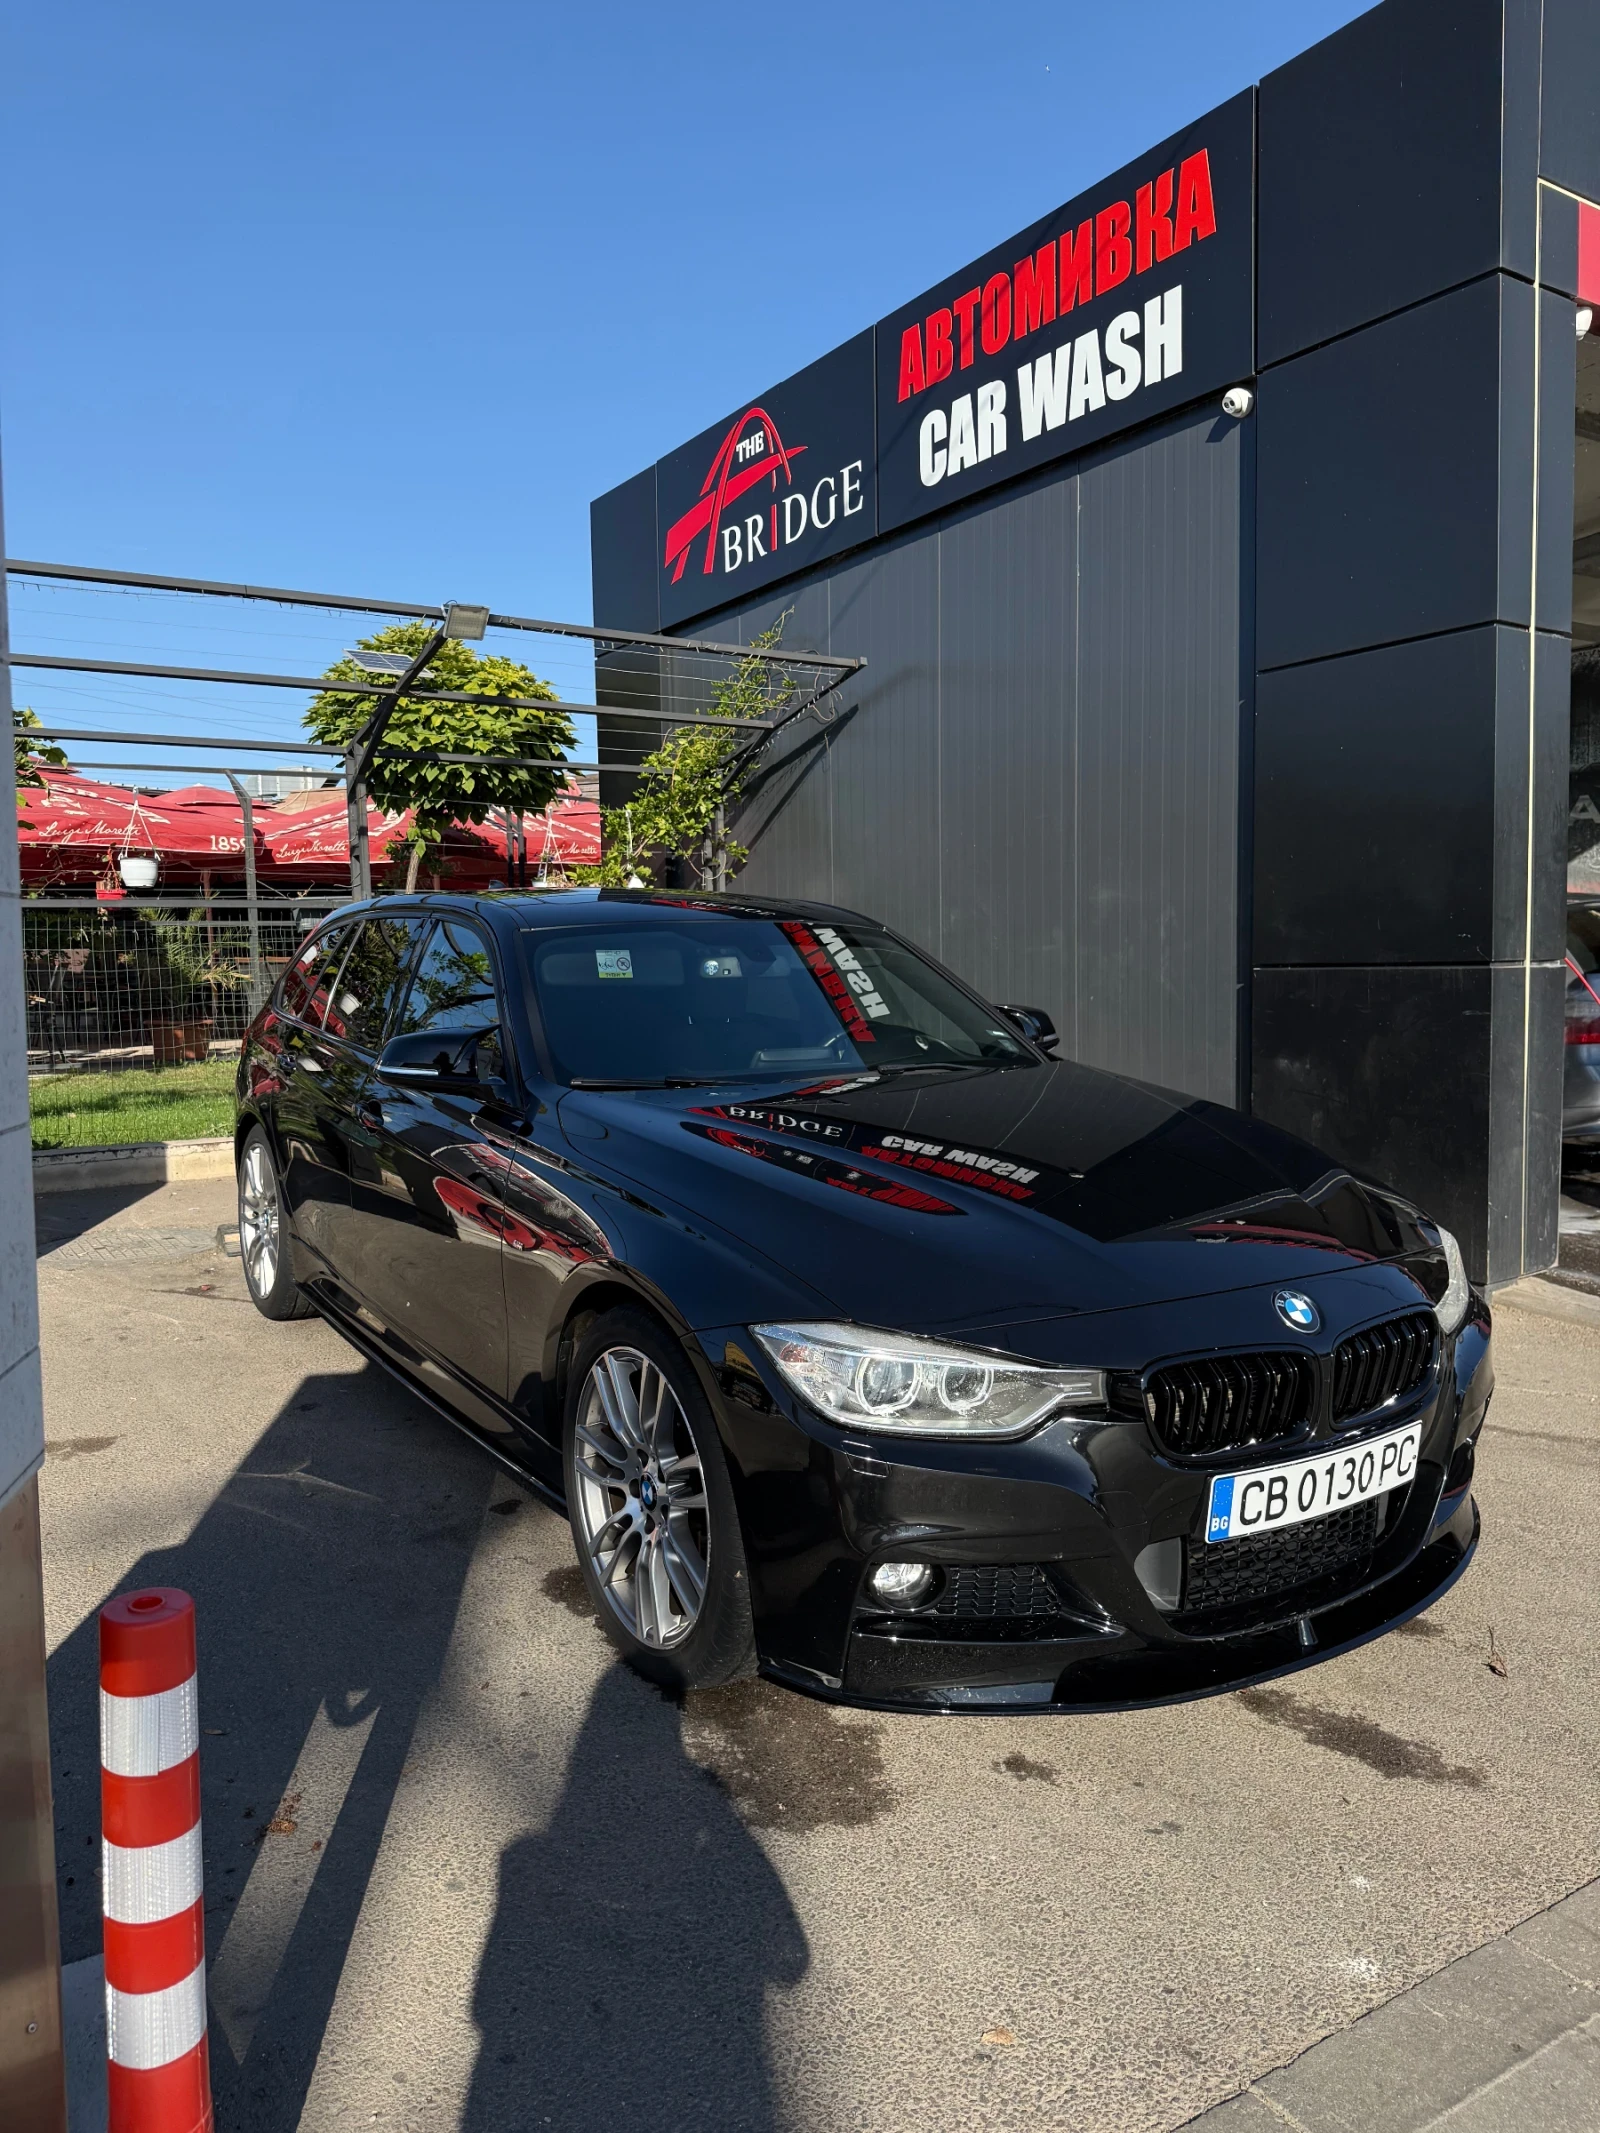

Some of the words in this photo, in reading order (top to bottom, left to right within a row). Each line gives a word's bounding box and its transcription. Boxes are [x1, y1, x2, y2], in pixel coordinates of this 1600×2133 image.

[897, 147, 1217, 403] АВТОМИВКА
[918, 379, 1007, 487] CAR
[1017, 284, 1184, 441] WASH
[735, 431, 765, 463] THE
[721, 459, 864, 574] BRIDGE
[38, 821, 83, 844] Luigi
[85, 819, 143, 836] Moretti
[276, 843, 305, 862] Luigi
[1239, 1474, 1289, 1526] CB
[1298, 1450, 1375, 1513] 0130
[1377, 1434, 1416, 1487] PC
[1211, 1515, 1229, 1532] BG
